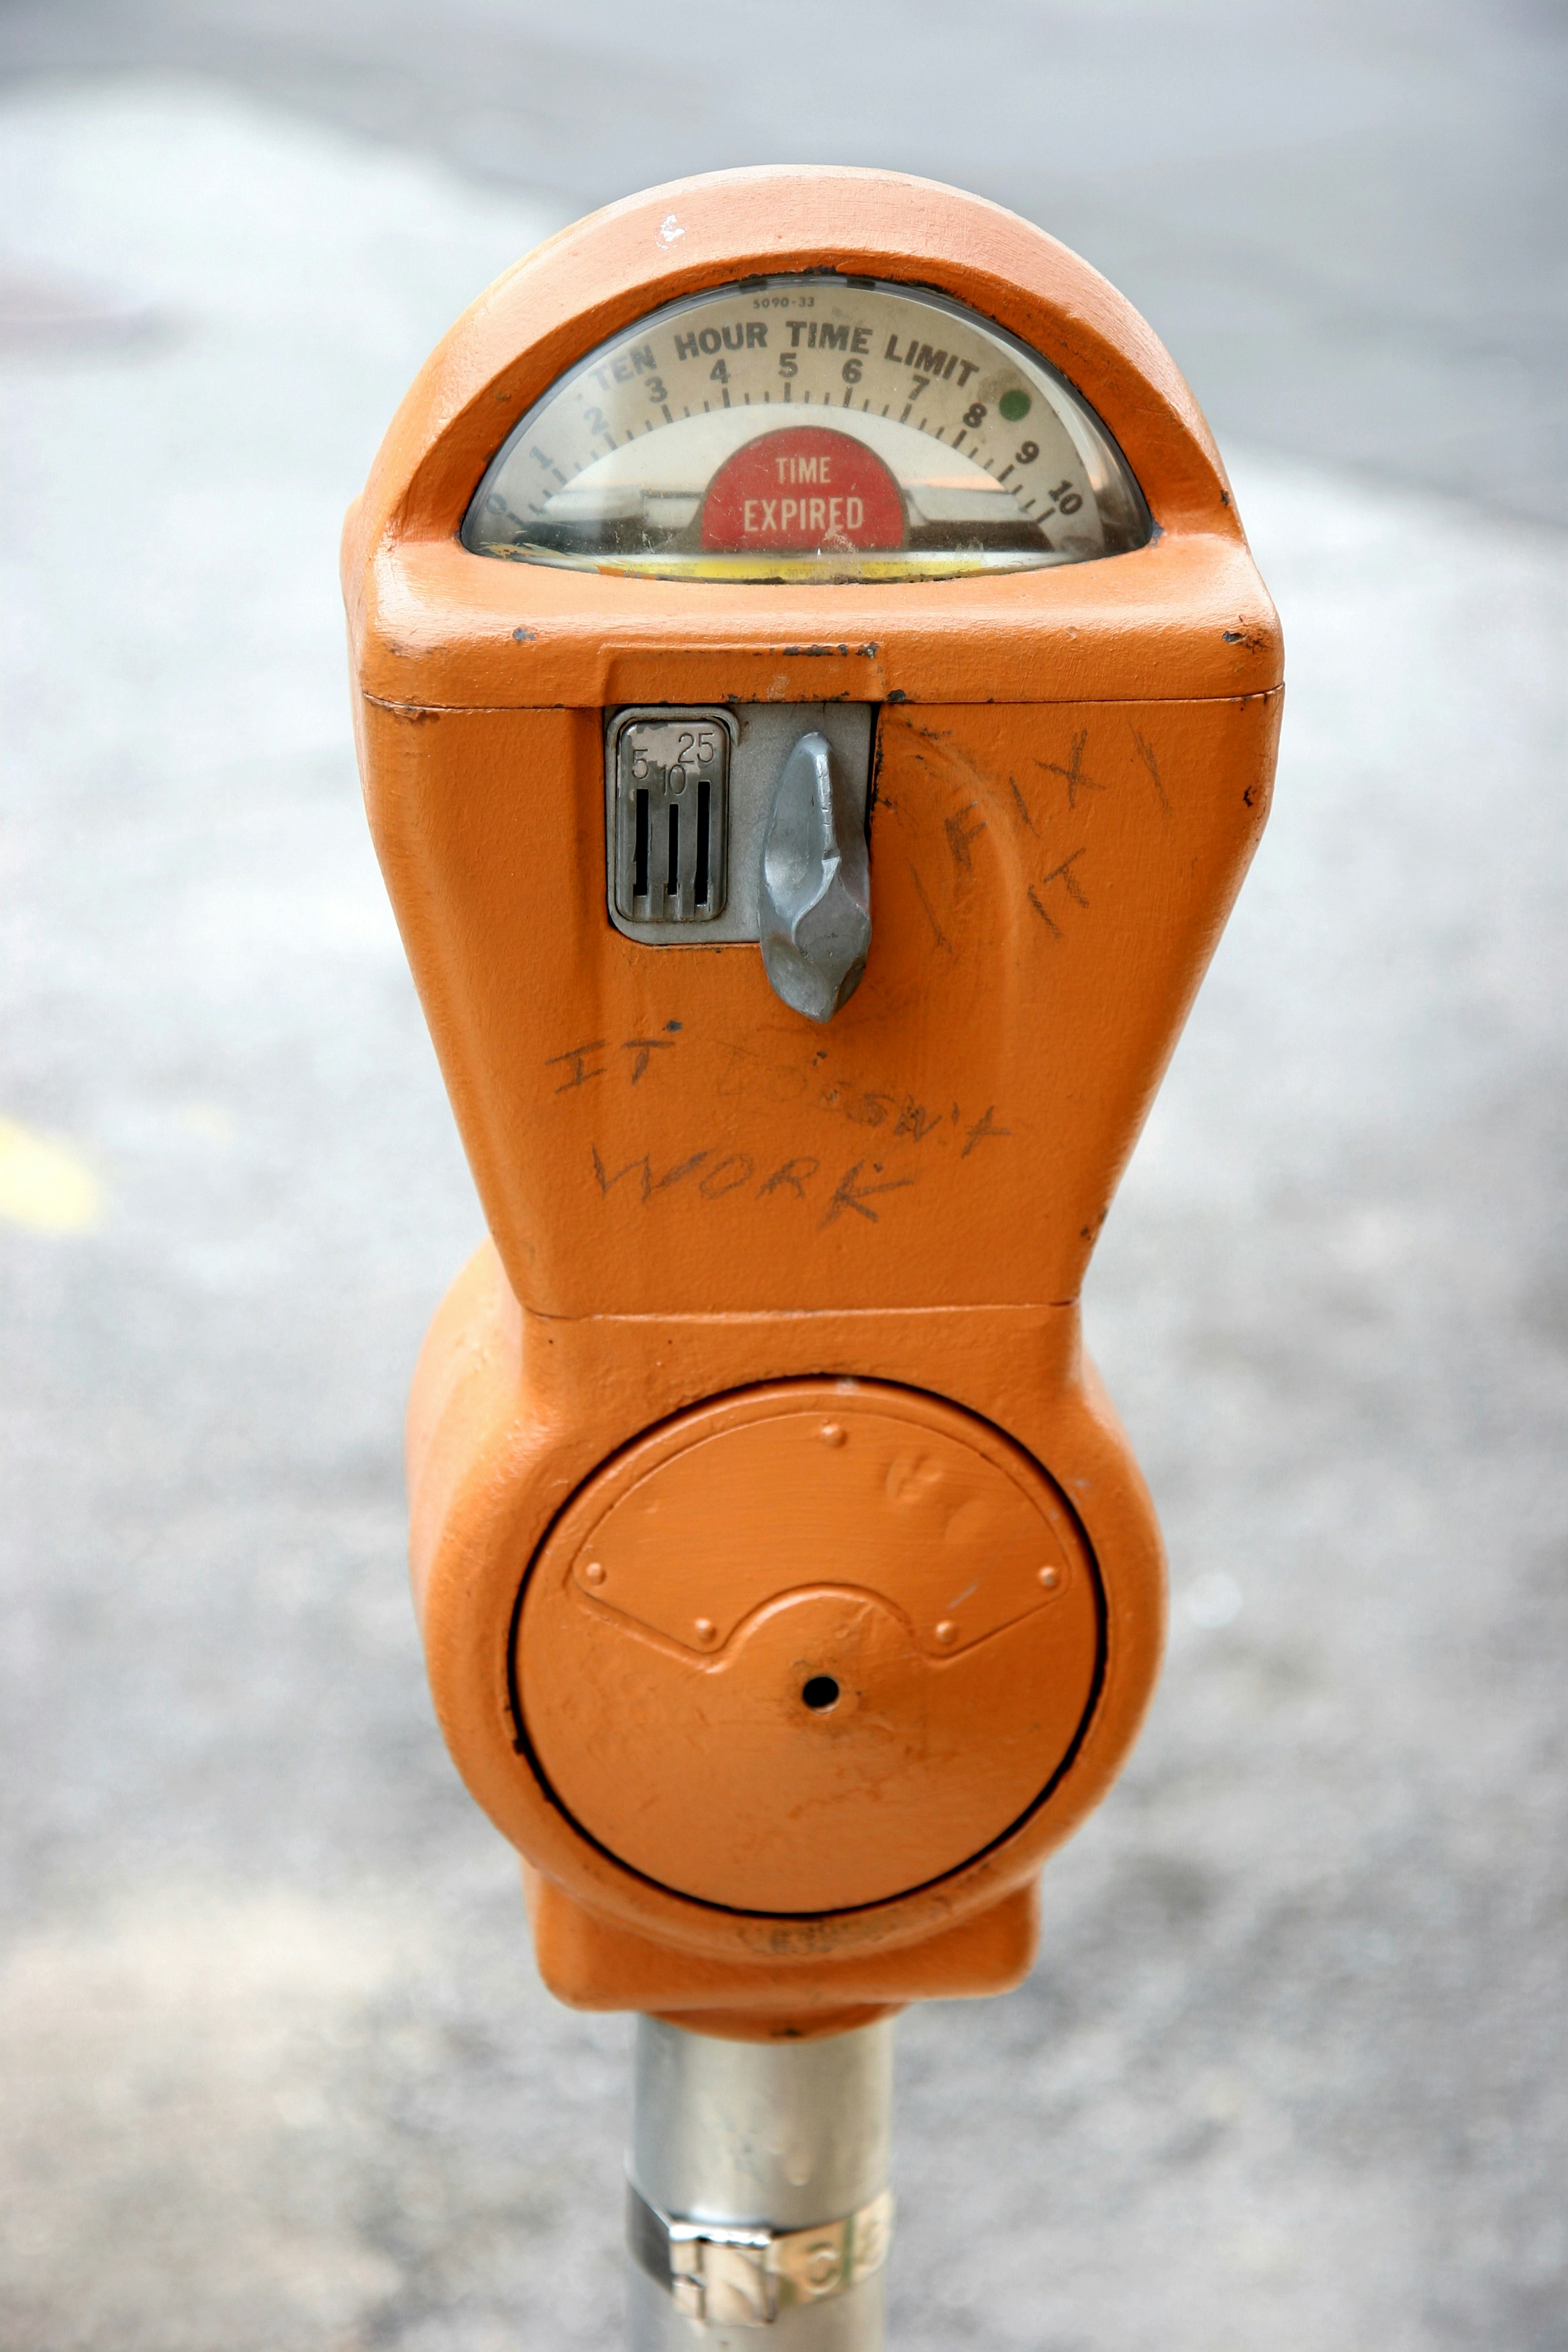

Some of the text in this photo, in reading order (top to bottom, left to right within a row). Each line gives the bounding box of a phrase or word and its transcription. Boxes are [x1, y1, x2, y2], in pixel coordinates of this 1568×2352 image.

[752, 296, 815, 309] 5090-33
[588, 320, 979, 392] TEN HOUR TIME LIMIT
[529, 445, 553, 468] 1
[583, 406, 610, 435] 2
[644, 376, 669, 403] 3
[709, 358, 732, 383] 4
[778, 352, 799, 378] 5
[841, 358, 864, 383] 6
[908, 375, 931, 401] 7
[963, 403, 987, 429] 8
[1015, 440, 1040, 464] 9
[1048, 479, 1084, 516] 10
[775, 456, 832, 484] TIME
[744, 497, 865, 532] EXPIRED
[632, 732, 716, 779] 5 25
[662, 763, 687, 796] 10
[545, 1038, 675, 1095] IT
[591, 1141, 916, 1231] WORK
